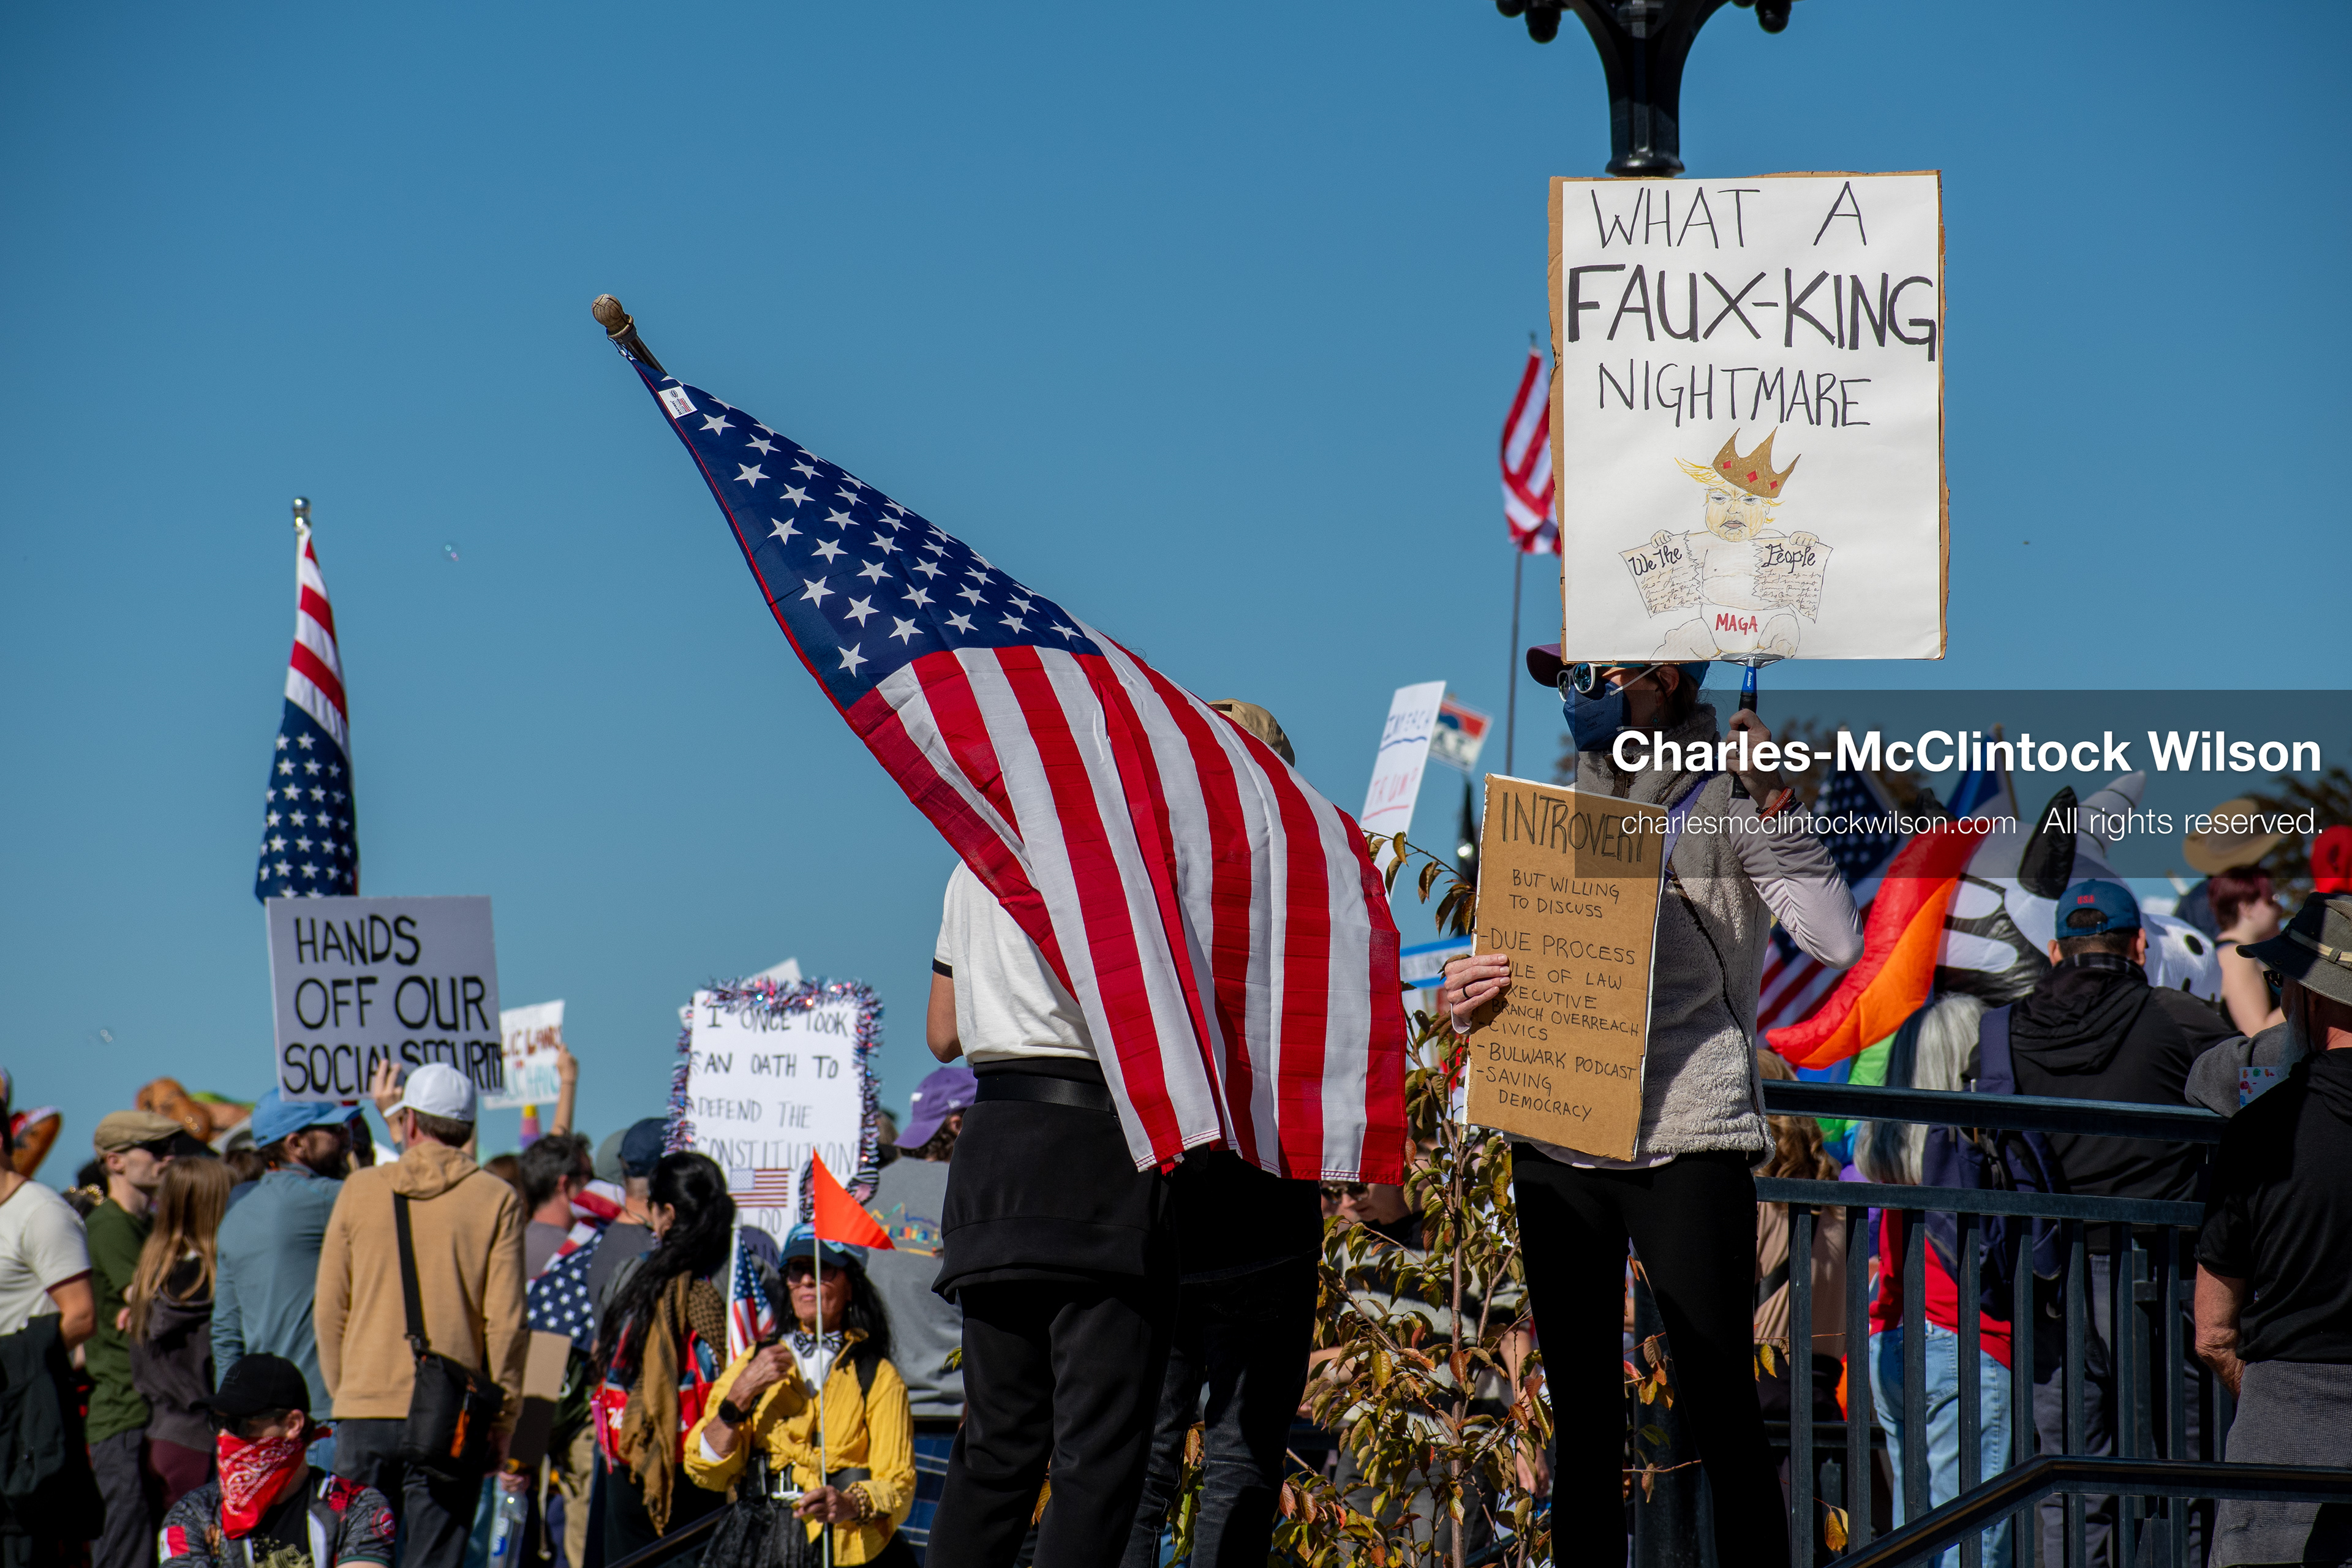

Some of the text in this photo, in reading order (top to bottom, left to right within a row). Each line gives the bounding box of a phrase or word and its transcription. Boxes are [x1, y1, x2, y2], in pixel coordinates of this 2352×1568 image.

[1591, 181, 1867, 249] WHAT A
[1568, 263, 1936, 362] FAUX-KING
[1598, 358, 1871, 428] NIGHTMARE
[1627, 556, 1656, 576] We
[1761, 543, 1817, 574] People
[1715, 612, 1758, 635] MAGA
[1502, 791, 1658, 864] INTROVERT
[1512, 869, 1620, 905] BUT WILLING
[2077, 894, 2095, 905] USA
[1509, 894, 1603, 919] TO DISCUSS
[295, 914, 421, 966] HANDS
[1542, 934, 1636, 965] PROCESS
[1510, 960, 1623, 990] LE OF LAW
[295, 974, 491, 1031] OFF OUR
[1499, 984, 1597, 1009] XECUTIVE
[707, 1005, 722, 1027] I
[1492, 998, 1639, 1037] BRANCH OVERREACH
[704, 1051, 840, 1079] AN OATH TO
[1575, 1056, 1637, 1081] PODCAST
[697, 1096, 813, 1129] DEFEND THE
[1499, 1089, 1593, 1122] DEMOCRACY
